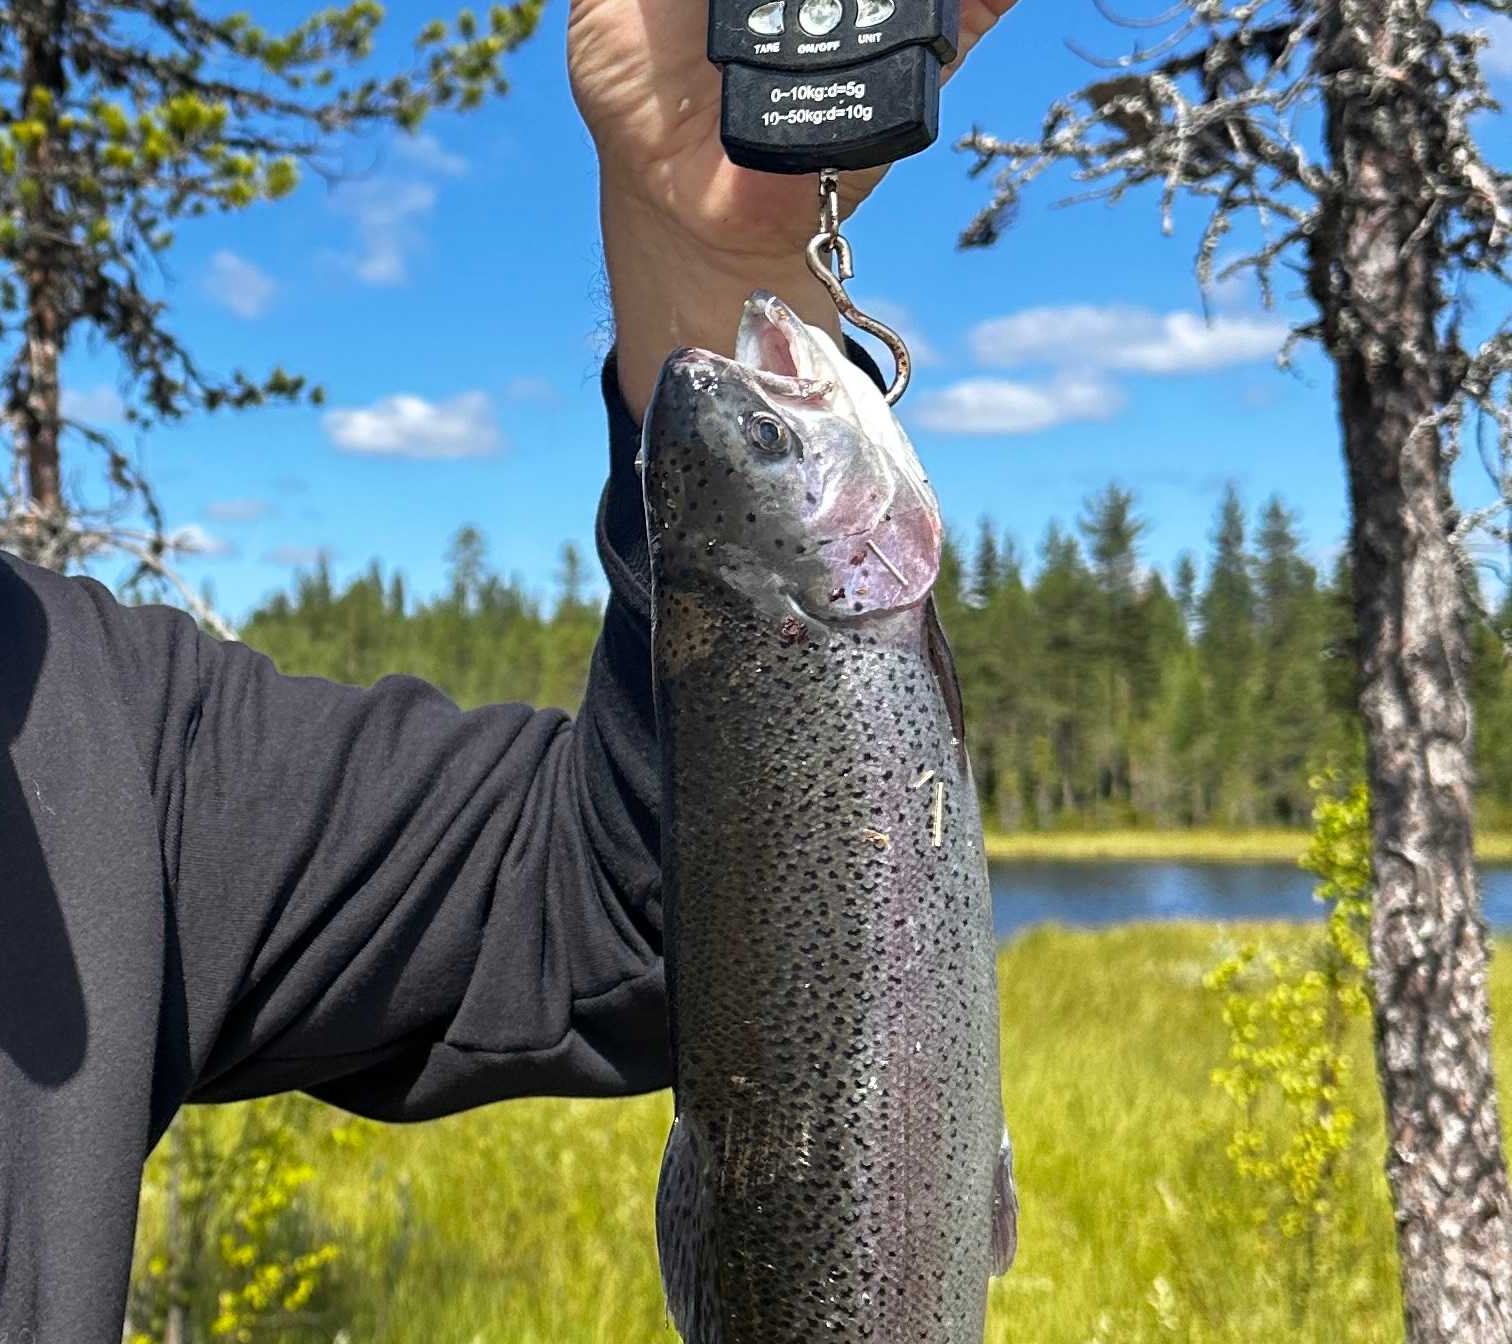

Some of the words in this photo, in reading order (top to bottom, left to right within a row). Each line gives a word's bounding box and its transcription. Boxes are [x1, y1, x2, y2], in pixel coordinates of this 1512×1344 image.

[753, 42, 781, 55] TARE
[797, 40, 841, 55] ON/OFF
[857, 32, 883, 44] UNIT
